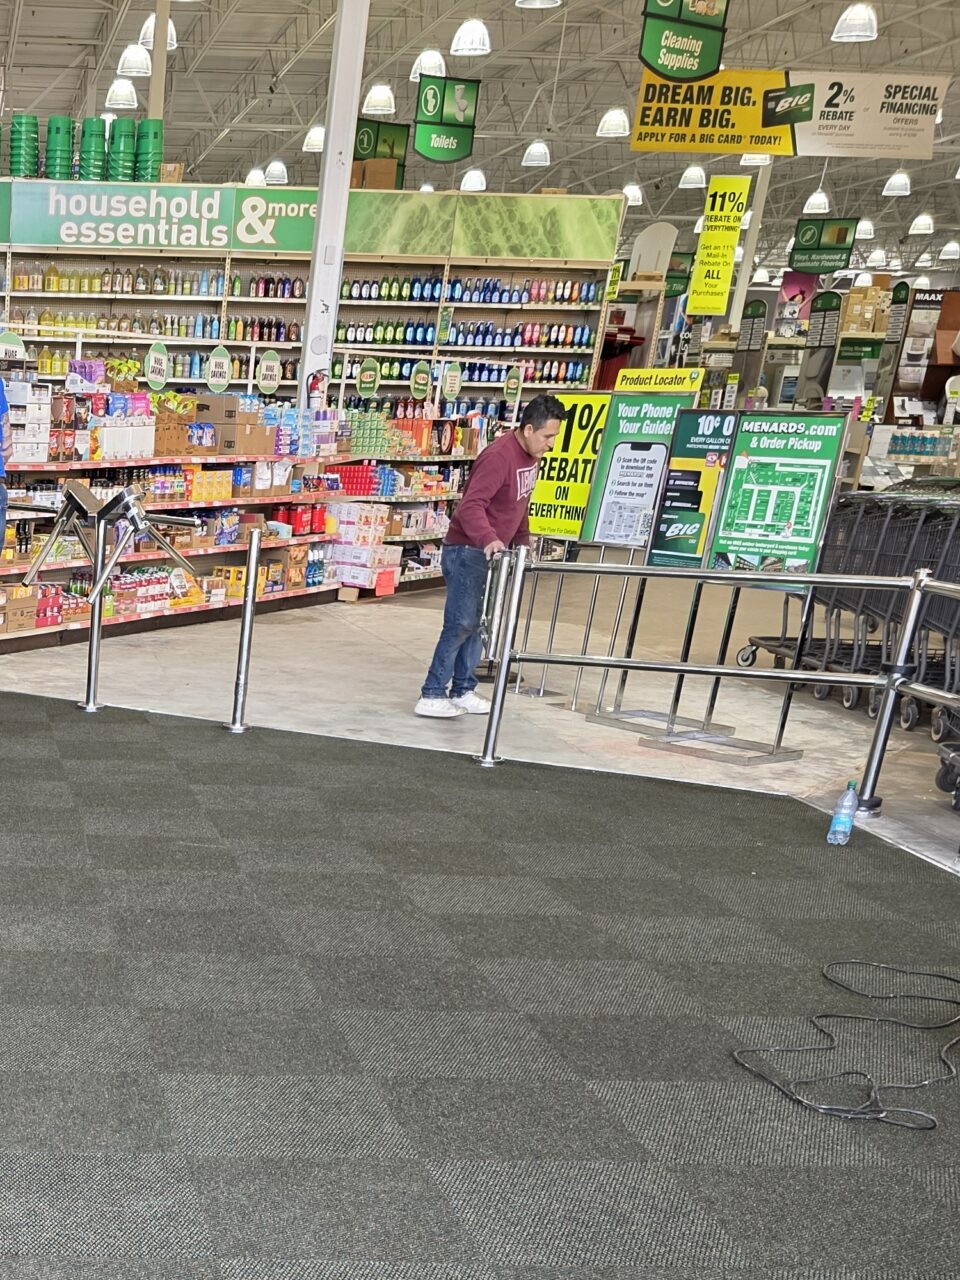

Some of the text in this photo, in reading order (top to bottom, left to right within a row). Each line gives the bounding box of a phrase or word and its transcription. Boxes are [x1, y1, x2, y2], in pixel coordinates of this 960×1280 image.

[661, 30, 702, 56] Cleaning
[658, 50, 699, 71] Supplies
[642, 84, 757, 108] DREAM BIG.
[824, 82, 855, 109] 2%
[883, 84, 938, 102] SPECIAL
[775, 94, 811, 112] BIG
[880, 101, 938, 116] FINANCING
[639, 106, 736, 129] EARN BIG.
[819, 110, 855, 122] REBATE
[892, 118, 919, 126] OFFERS
[838, 124, 851, 132] DAY
[430, 134, 458, 149] Toilets
[637, 132, 666, 143] APPLY
[669, 133, 688, 143] FOR
[690, 133, 698, 143] A
[700, 133, 715, 144] BIG
[749, 134, 782, 146] TODAY!
[48, 186, 221, 219] household
[709, 191, 744, 213] 11%
[236, 196, 318, 244] & more
[704, 214, 742, 224] REBATE ON
[60, 218, 229, 246] essentials
[793, 260, 846, 269] Laminate Flooring
[794, 252, 811, 261] Vinyl,
[811, 254, 840, 262] Hardwood
[704, 270, 721, 280] ALL
[671, 283, 684, 291] Tile
[704, 281, 719, 290] Your
[914, 292, 943, 302] MAAX
[5, 348, 18, 359] HUGE
[153, 355, 163, 367] HUGE
[150, 365, 166, 378] SAVINGS
[213, 360, 224, 369] HUGE
[264, 363, 275, 372] HUGE
[209, 369, 227, 381] SAVINGS
[261, 371, 278, 382] SAVINGS
[620, 374, 686, 387] Product Locator
[618, 403, 640, 418] Your
[641, 403, 673, 419] Phone
[556, 403, 607, 454] 1%
[619, 420, 675, 436] Your Guide!
[697, 415, 721, 435] 10¢
[749, 436, 822, 453] & Order Pickup
[537, 457, 596, 484] REBAT
[555, 486, 570, 501] ON
[529, 502, 586, 521] EVERYTHIN
[665, 523, 700, 537] BIG
